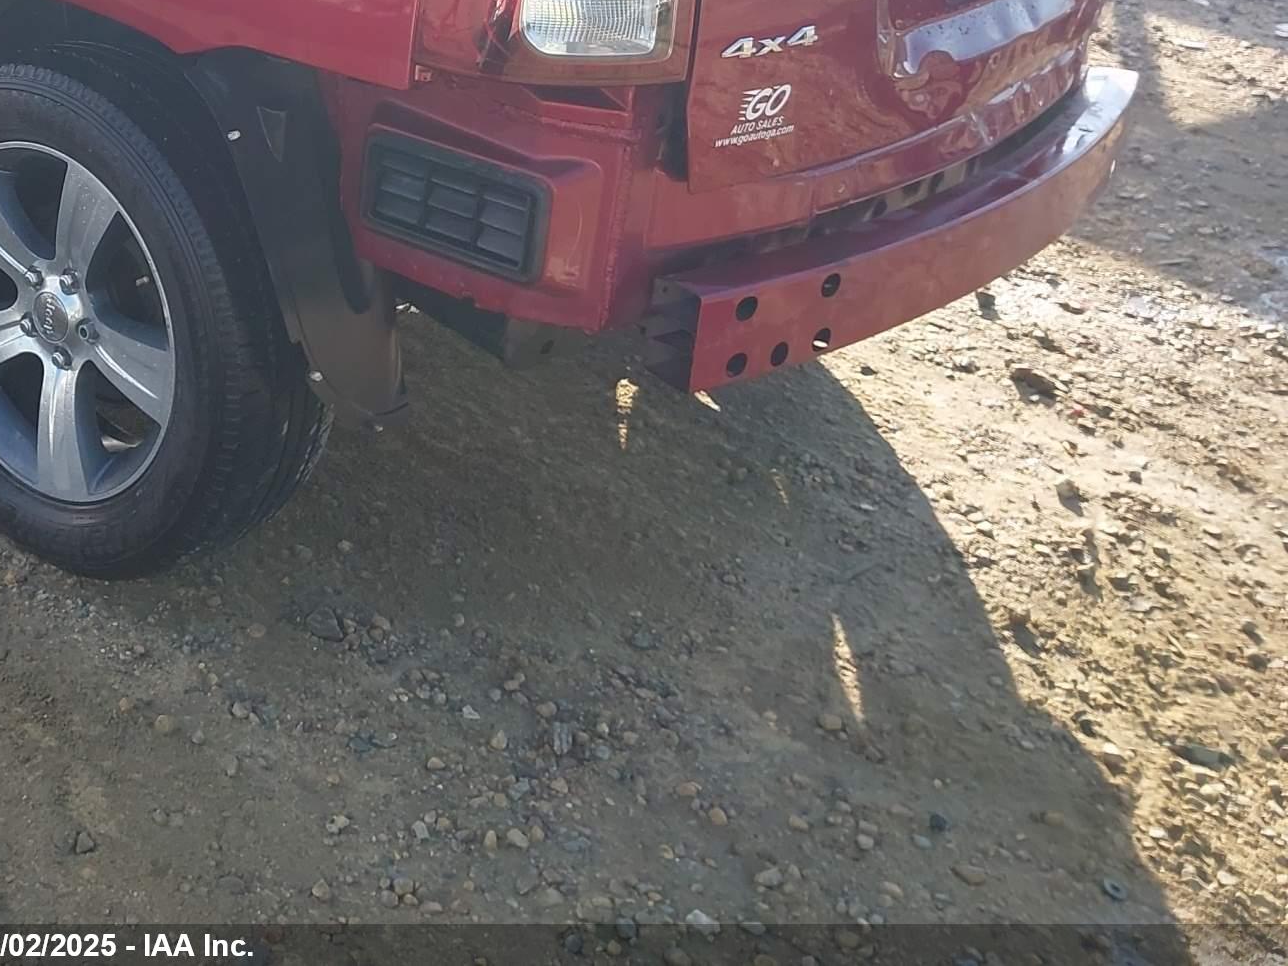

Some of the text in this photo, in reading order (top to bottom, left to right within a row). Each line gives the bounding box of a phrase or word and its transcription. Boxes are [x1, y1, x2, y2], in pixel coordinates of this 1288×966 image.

[721, 25, 818, 58] 4x4
[745, 84, 792, 120] GO
[730, 115, 785, 135] AUTO SALES
